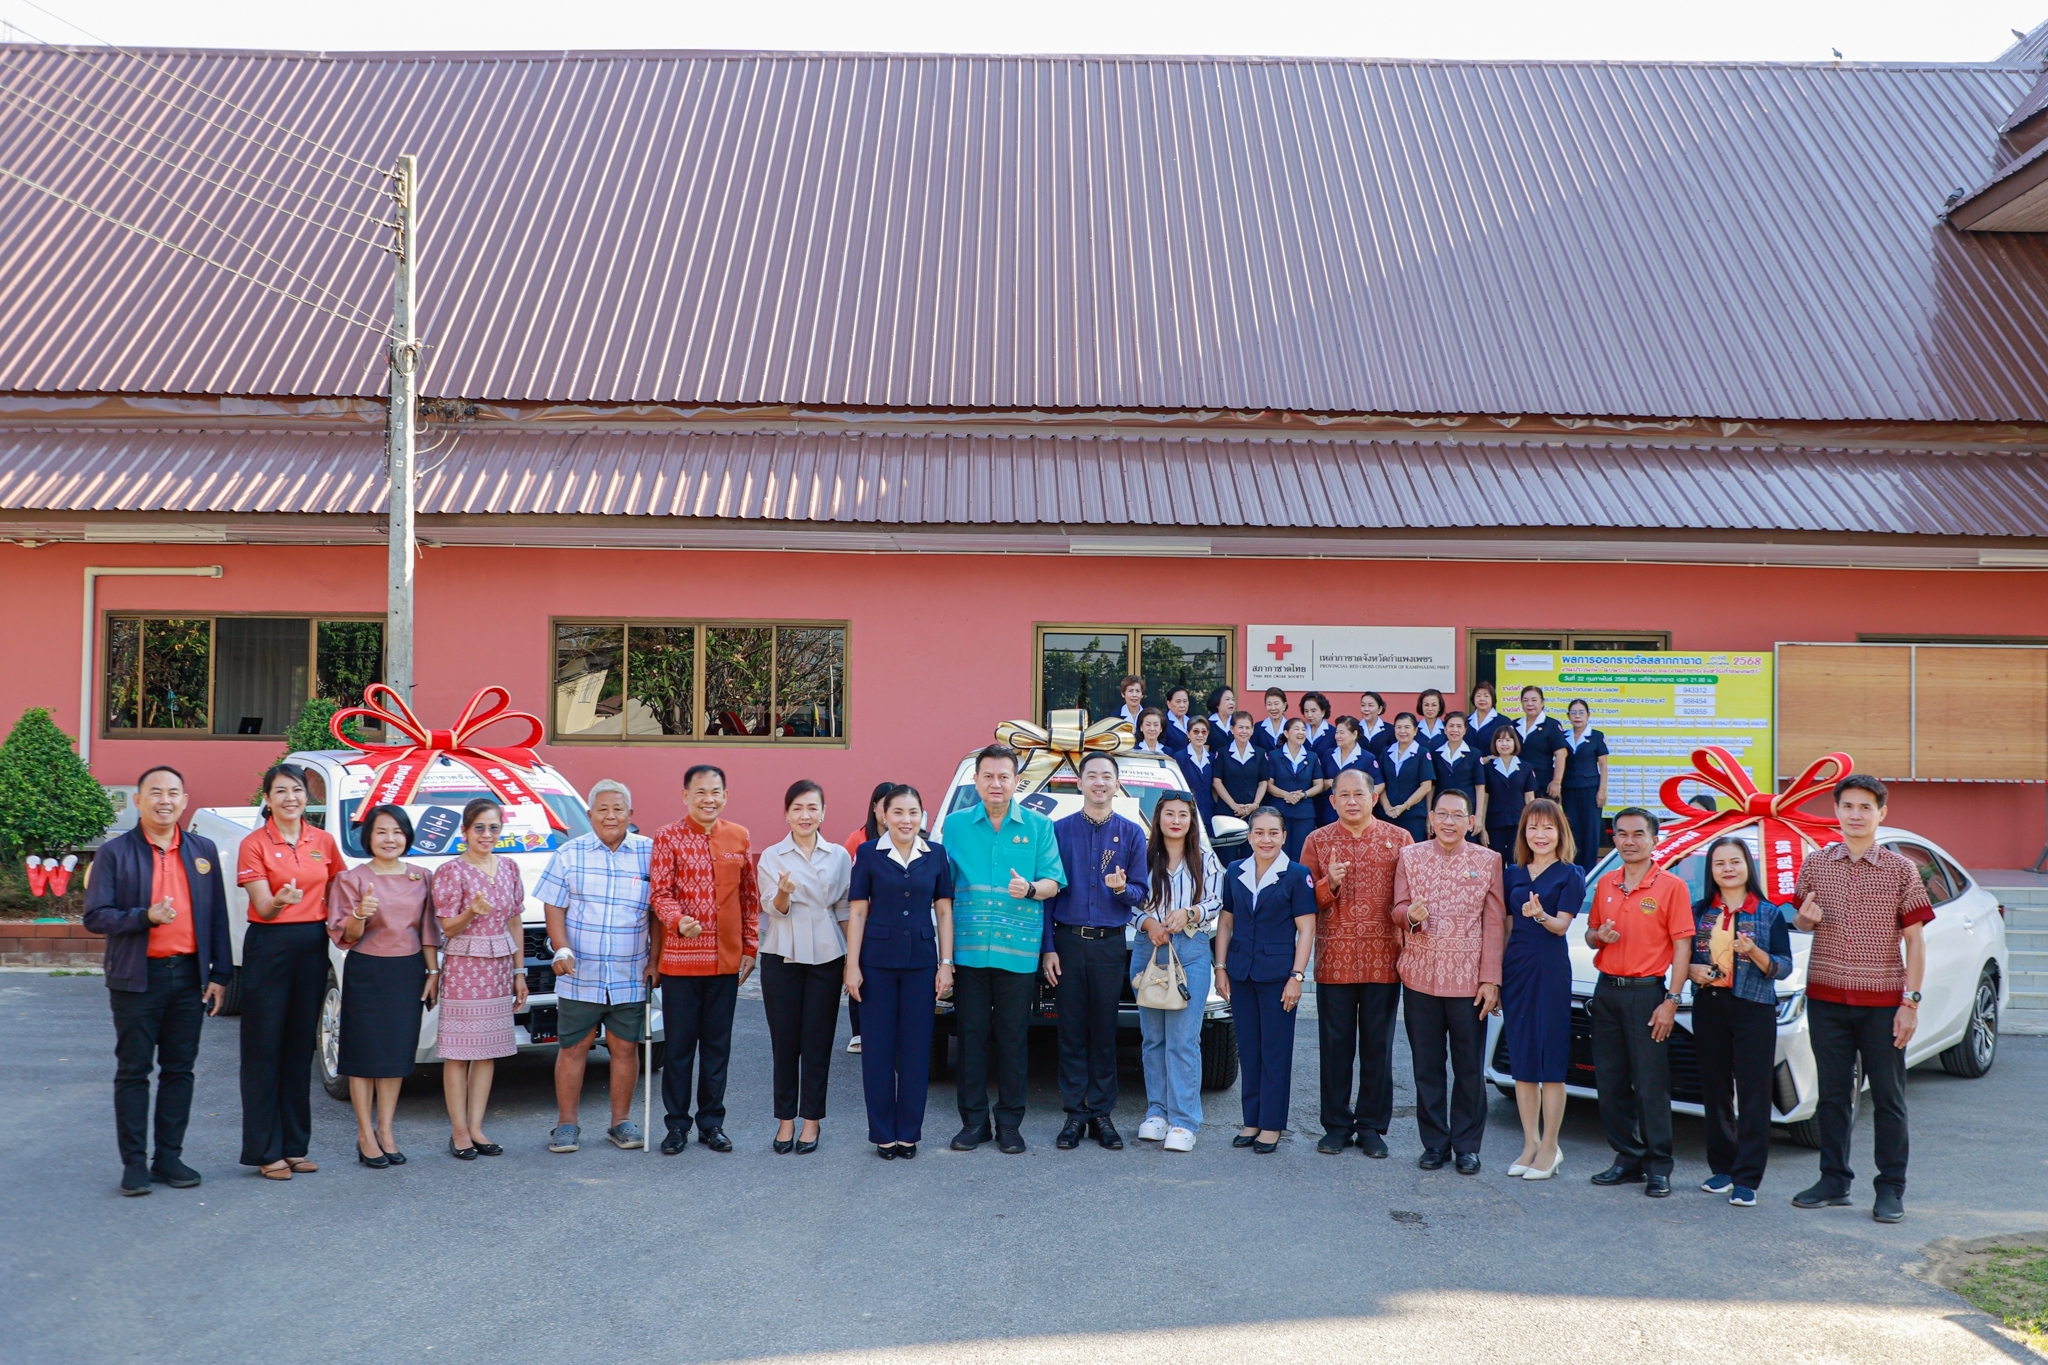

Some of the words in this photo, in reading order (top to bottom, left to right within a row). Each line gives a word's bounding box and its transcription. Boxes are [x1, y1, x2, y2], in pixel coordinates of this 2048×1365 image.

[1319, 653, 1433, 663] เหล่ากาชาดจังหวัดกำแพงเพชร
[1562, 655, 1702, 665] ผลการออกรางวัลสลากกาชาด
[1733, 657, 1762, 666] 2568
[1252, 663, 1306, 673] สภากาชาดไทย
[1683, 686, 1707, 694] 943312
[487, 768, 509, 781] 098
[502, 781, 524, 795] 750
[525, 833, 541, 847] 2
[1774, 840, 1791, 854] 098
[1776, 855, 1793, 870] 750
[1777, 871, 1795, 895] 9955
